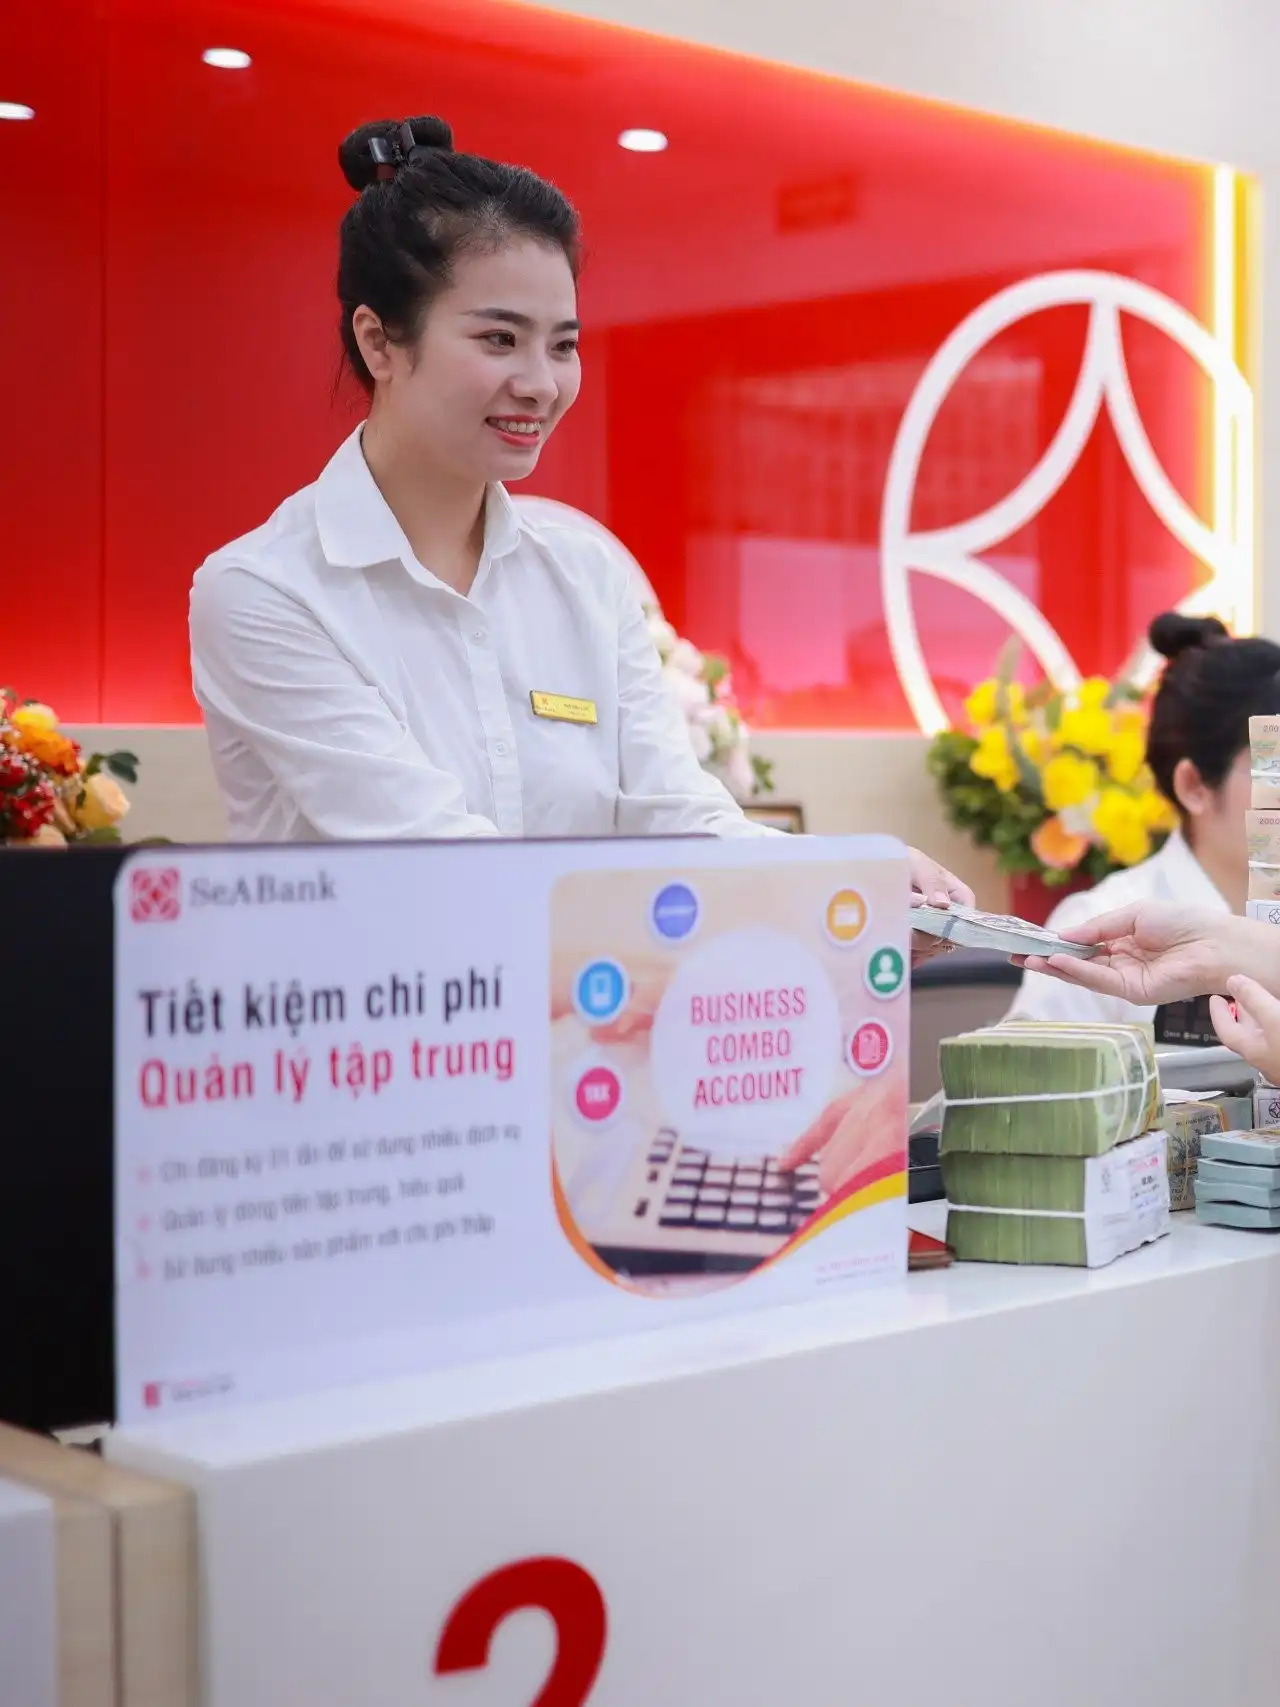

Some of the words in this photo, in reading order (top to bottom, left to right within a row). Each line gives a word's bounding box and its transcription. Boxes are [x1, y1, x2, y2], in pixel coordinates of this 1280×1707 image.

[189, 869, 337, 908] SeABank
[138, 976, 225, 1039] Tiết
[244, 978, 346, 1038] kiệm
[365, 970, 427, 1020] chi
[442, 964, 504, 1025] phí
[690, 986, 807, 1026] BUSINESS
[706, 1027, 793, 1066] COMBO
[138, 1053, 254, 1109] Quản
[274, 1046, 310, 1103] lý
[329, 1041, 393, 1100] tập
[411, 1036, 517, 1082] trung
[693, 1066, 805, 1110] ACCOUNT
[431, 1552, 609, 1707] 2
